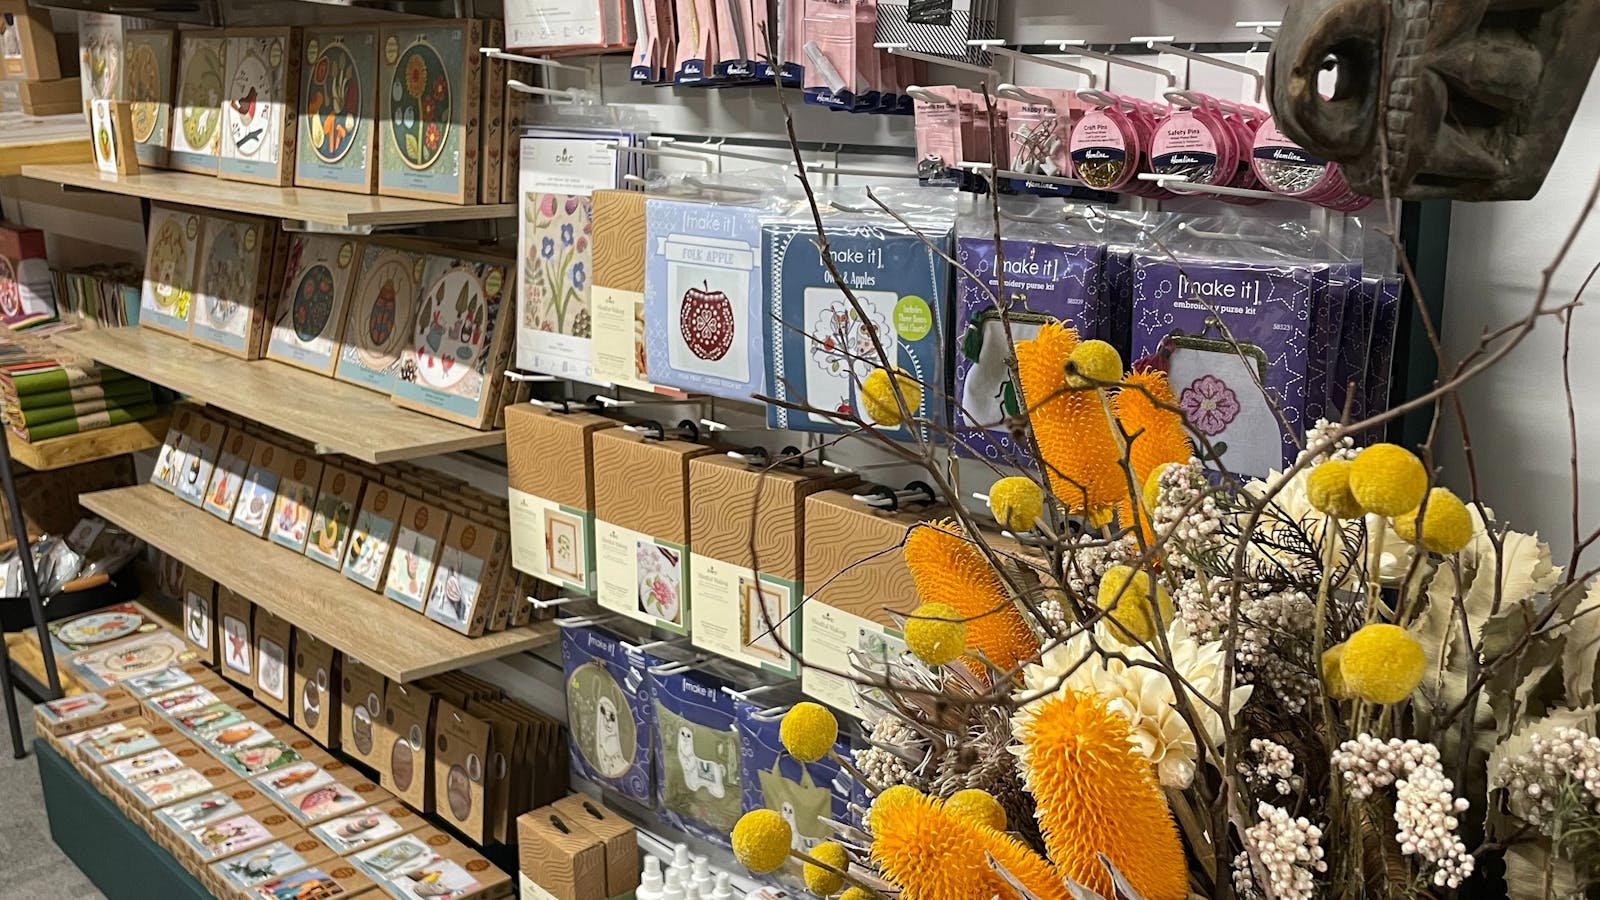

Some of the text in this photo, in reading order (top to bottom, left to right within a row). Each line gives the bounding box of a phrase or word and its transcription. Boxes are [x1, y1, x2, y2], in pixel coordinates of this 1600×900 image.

[1043, 106, 1057, 115] Pins
[1168, 129, 1186, 137] Safety
[555, 155, 574, 163] DMC
[1085, 150, 1110, 159] Hemline
[1170, 154, 1199, 164] Hemline
[1273, 149, 1306, 162] Hemline
[682, 248, 735, 265] FOLK APPLE
[842, 271, 849, 284] &
[850, 271, 876, 289] Apples
[1026, 282, 1045, 290] purse
[1046, 282, 1055, 290] kit
[1220, 305, 1244, 314] purse
[1245, 306, 1256, 315] kit
